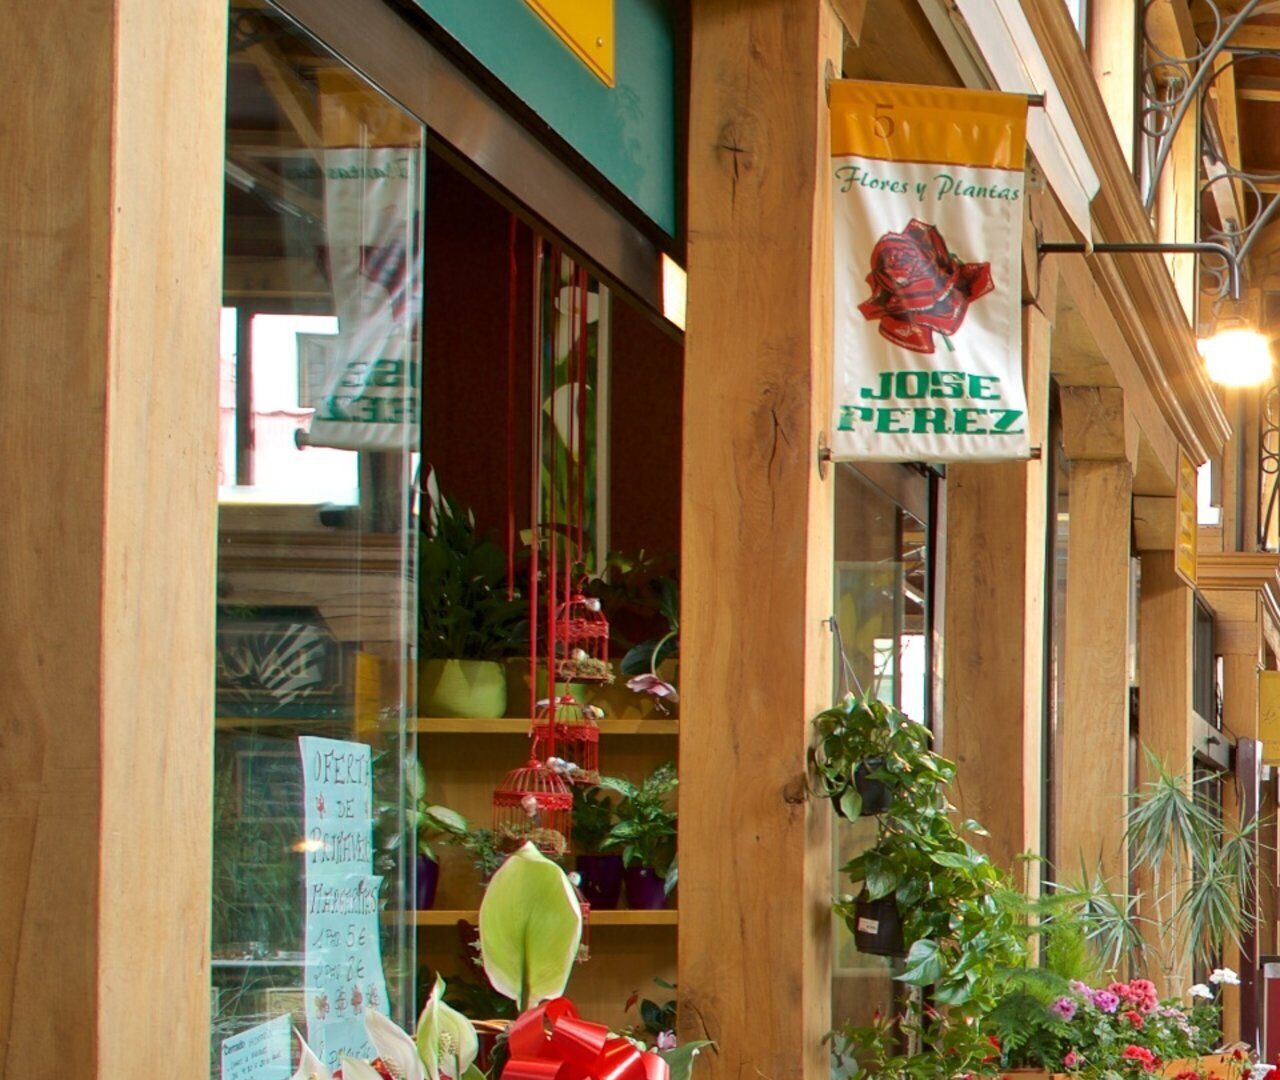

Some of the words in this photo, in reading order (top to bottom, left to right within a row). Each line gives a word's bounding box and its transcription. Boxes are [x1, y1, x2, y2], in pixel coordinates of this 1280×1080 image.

[873, 104, 895, 138] 5
[835, 166, 908, 194] Flores
[916, 183, 926, 201] y
[933, 174, 1020, 201] Plantas
[860, 371, 1000, 400] JOSE
[836, 405, 1024, 435] PEREZ
